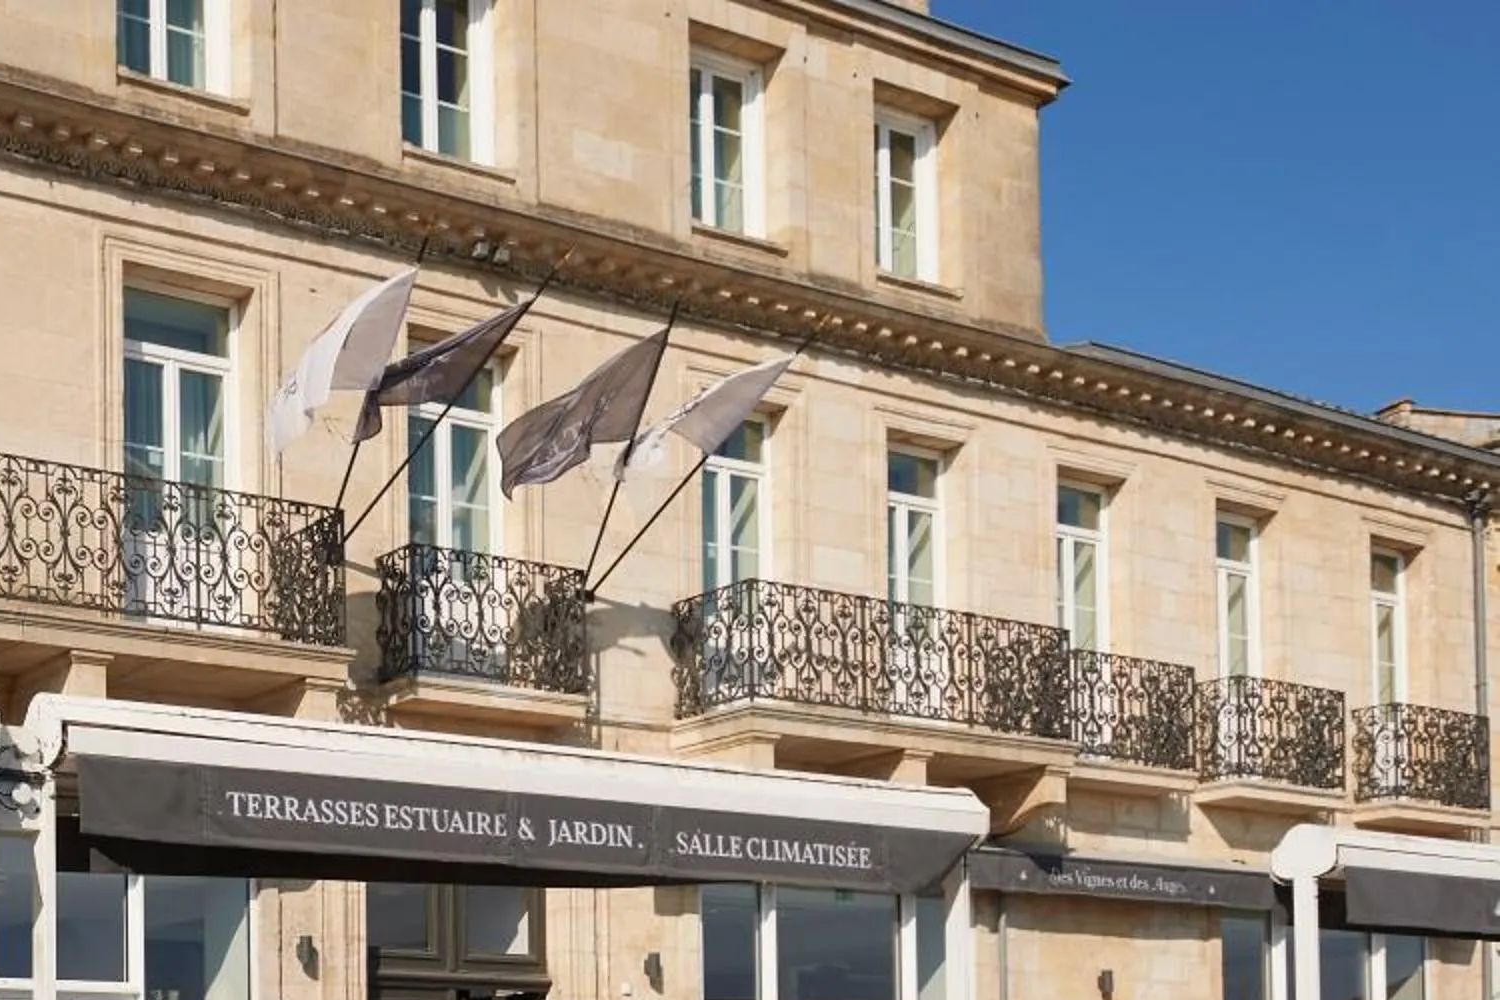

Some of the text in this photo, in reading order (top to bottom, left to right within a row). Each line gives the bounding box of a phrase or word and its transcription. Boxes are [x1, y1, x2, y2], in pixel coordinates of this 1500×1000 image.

[225, 791, 379, 828] TERRASSES
[384, 804, 507, 837] ESTUAIRE
[517, 817, 536, 841] &
[675, 828, 743, 859] SALLE
[746, 837, 873, 869] CLIMATISÉE
